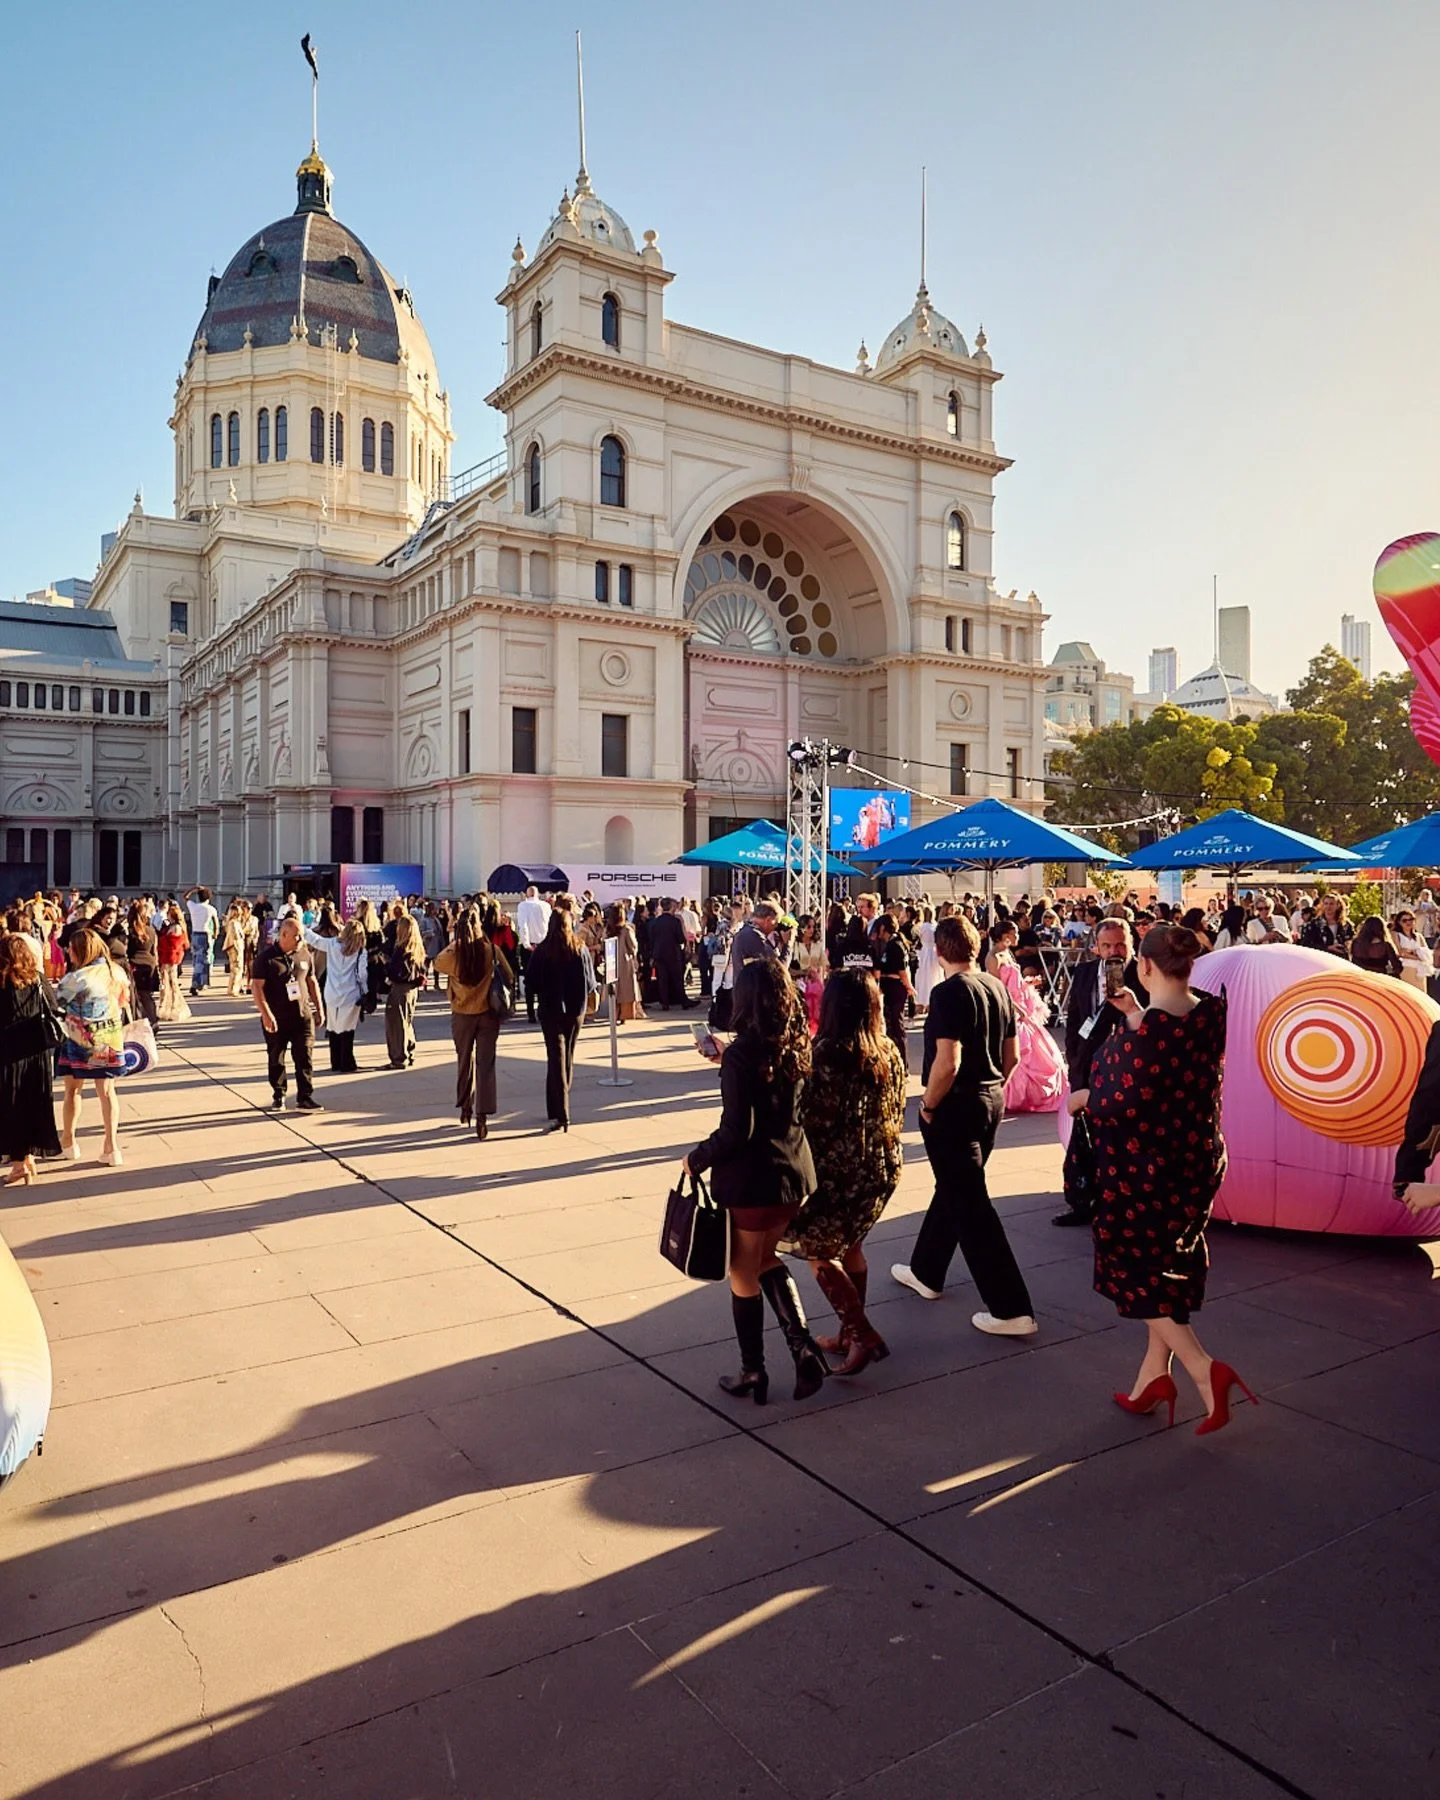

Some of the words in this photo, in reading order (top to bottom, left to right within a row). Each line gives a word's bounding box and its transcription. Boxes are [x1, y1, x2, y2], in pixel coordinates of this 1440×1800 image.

[923, 839, 1011, 850] POMMERY
[1173, 844, 1254, 857] POMMERY
[587, 873, 677, 882] PORSCHE
